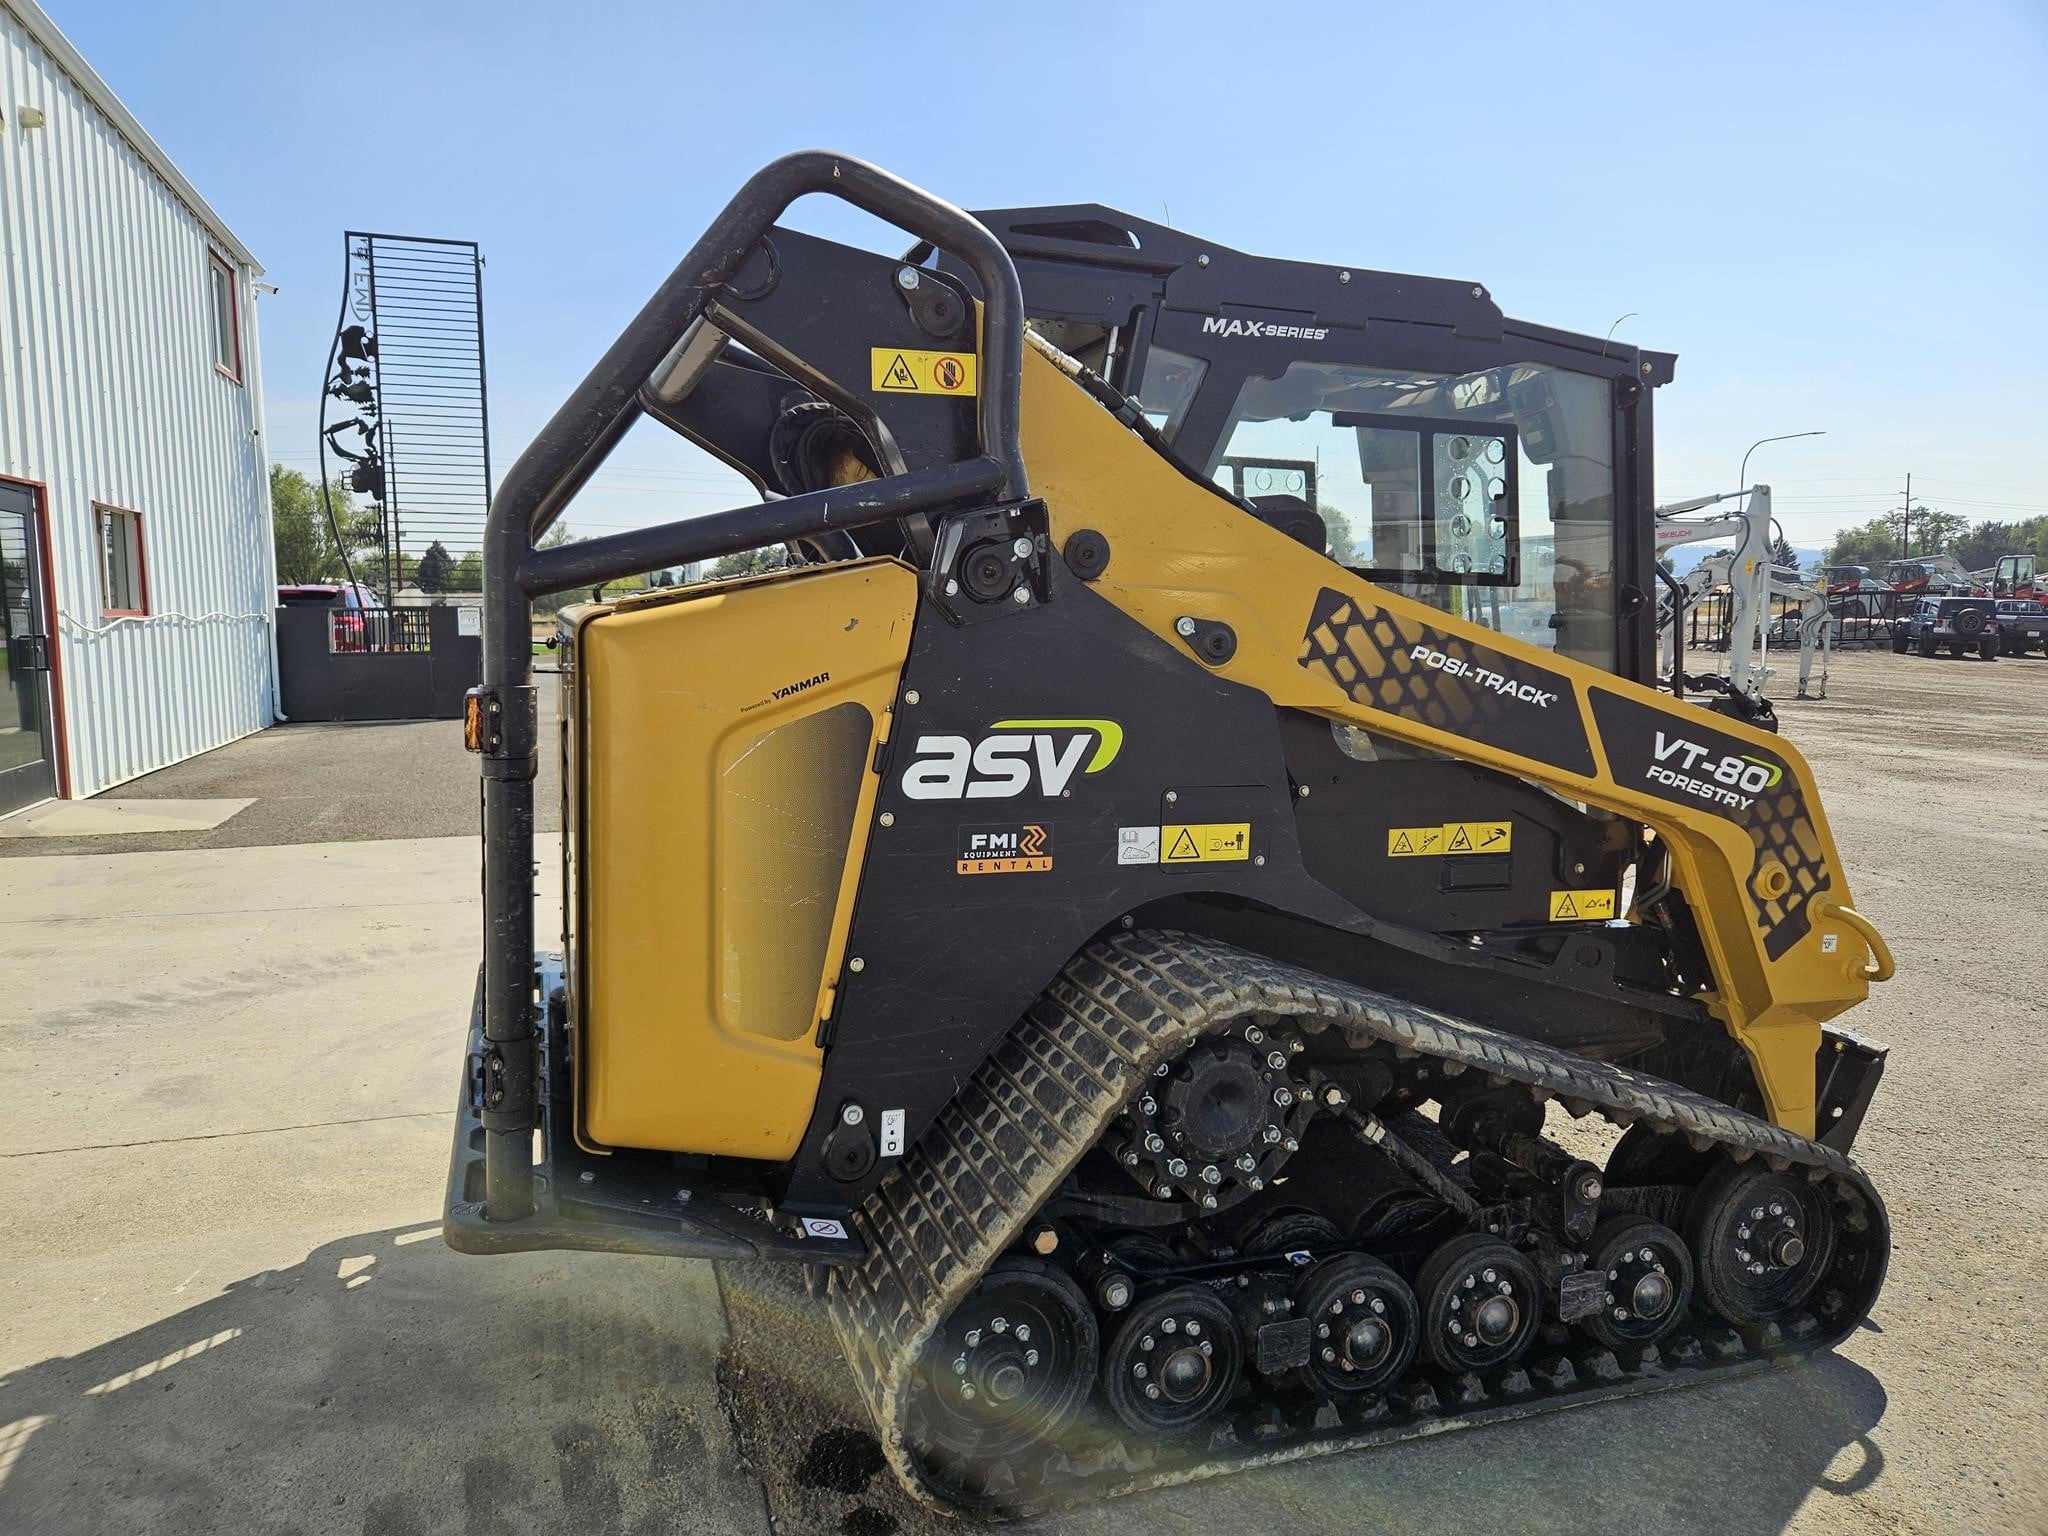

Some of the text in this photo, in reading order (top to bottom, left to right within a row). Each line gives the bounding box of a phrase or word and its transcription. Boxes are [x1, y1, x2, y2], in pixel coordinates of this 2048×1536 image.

[1202, 317, 1328, 340] MAX-SERIES
[740, 699, 766, 713] Powered
[772, 671, 831, 700] YANMAR
[1654, 731, 1770, 793] VT-80
[1645, 765, 1754, 810] FORESTRY
[971, 833, 1018, 850] FMI
[961, 860, 1048, 872] RENTAL
[963, 850, 1017, 859] EQUIPMENT
